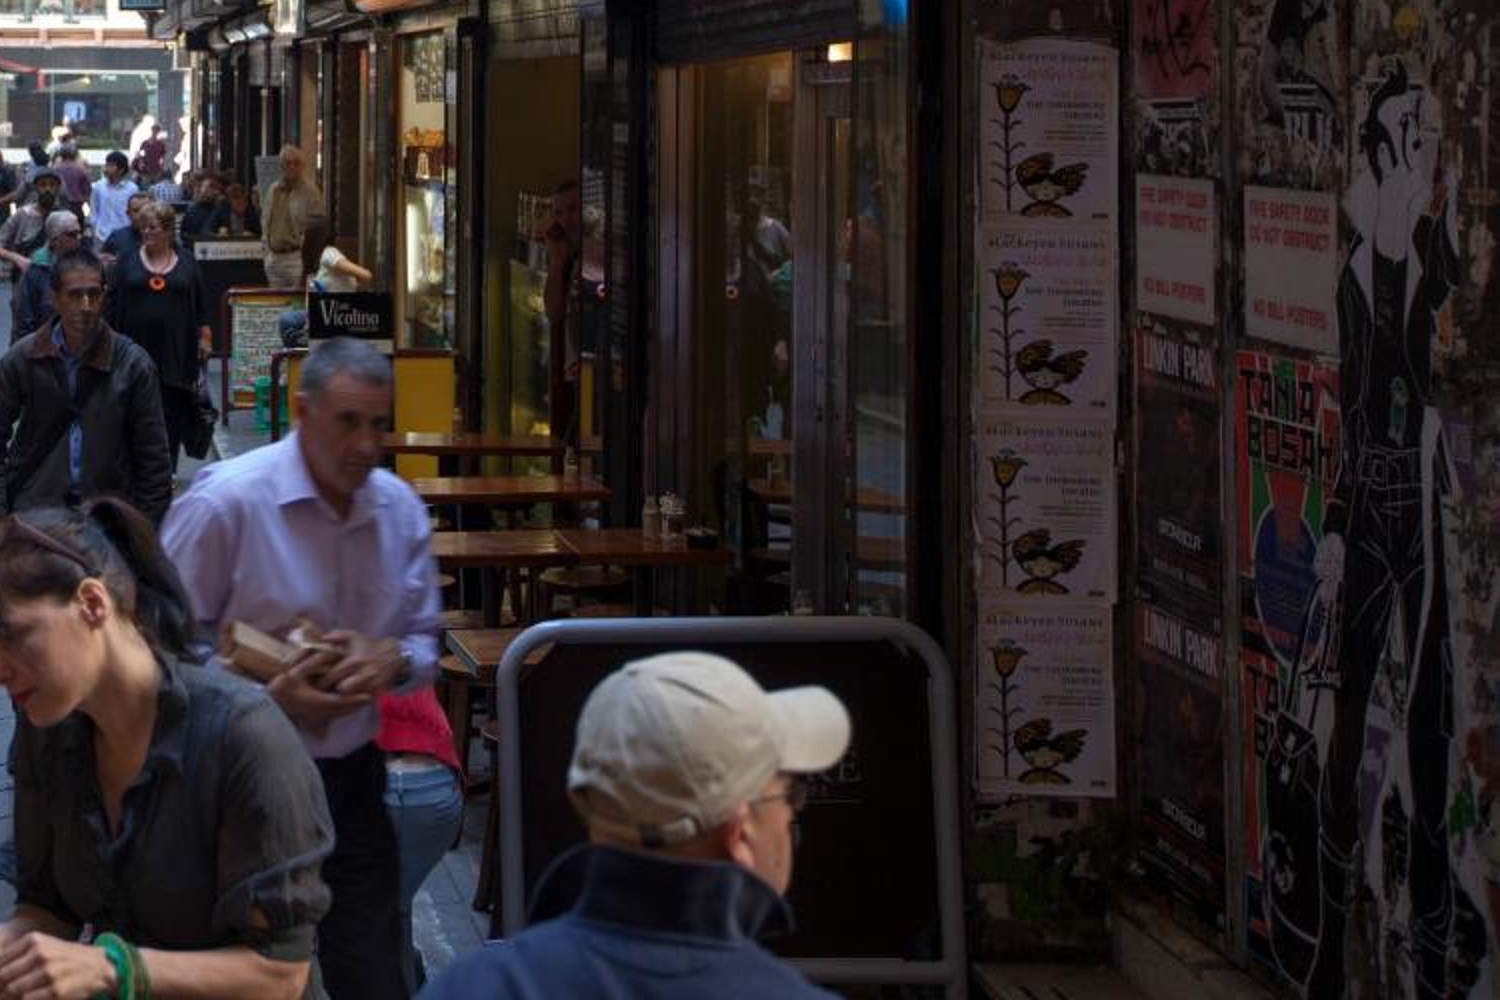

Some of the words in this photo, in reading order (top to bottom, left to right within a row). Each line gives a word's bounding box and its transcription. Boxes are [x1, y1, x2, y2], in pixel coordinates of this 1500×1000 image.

[320, 299, 380, 329] Vicolino
[1142, 333, 1181, 377] LINKIN
[1183, 345, 1217, 389] PARK
[1142, 605, 1184, 659] LINKIN
[1185, 626, 1220, 680] PARK
